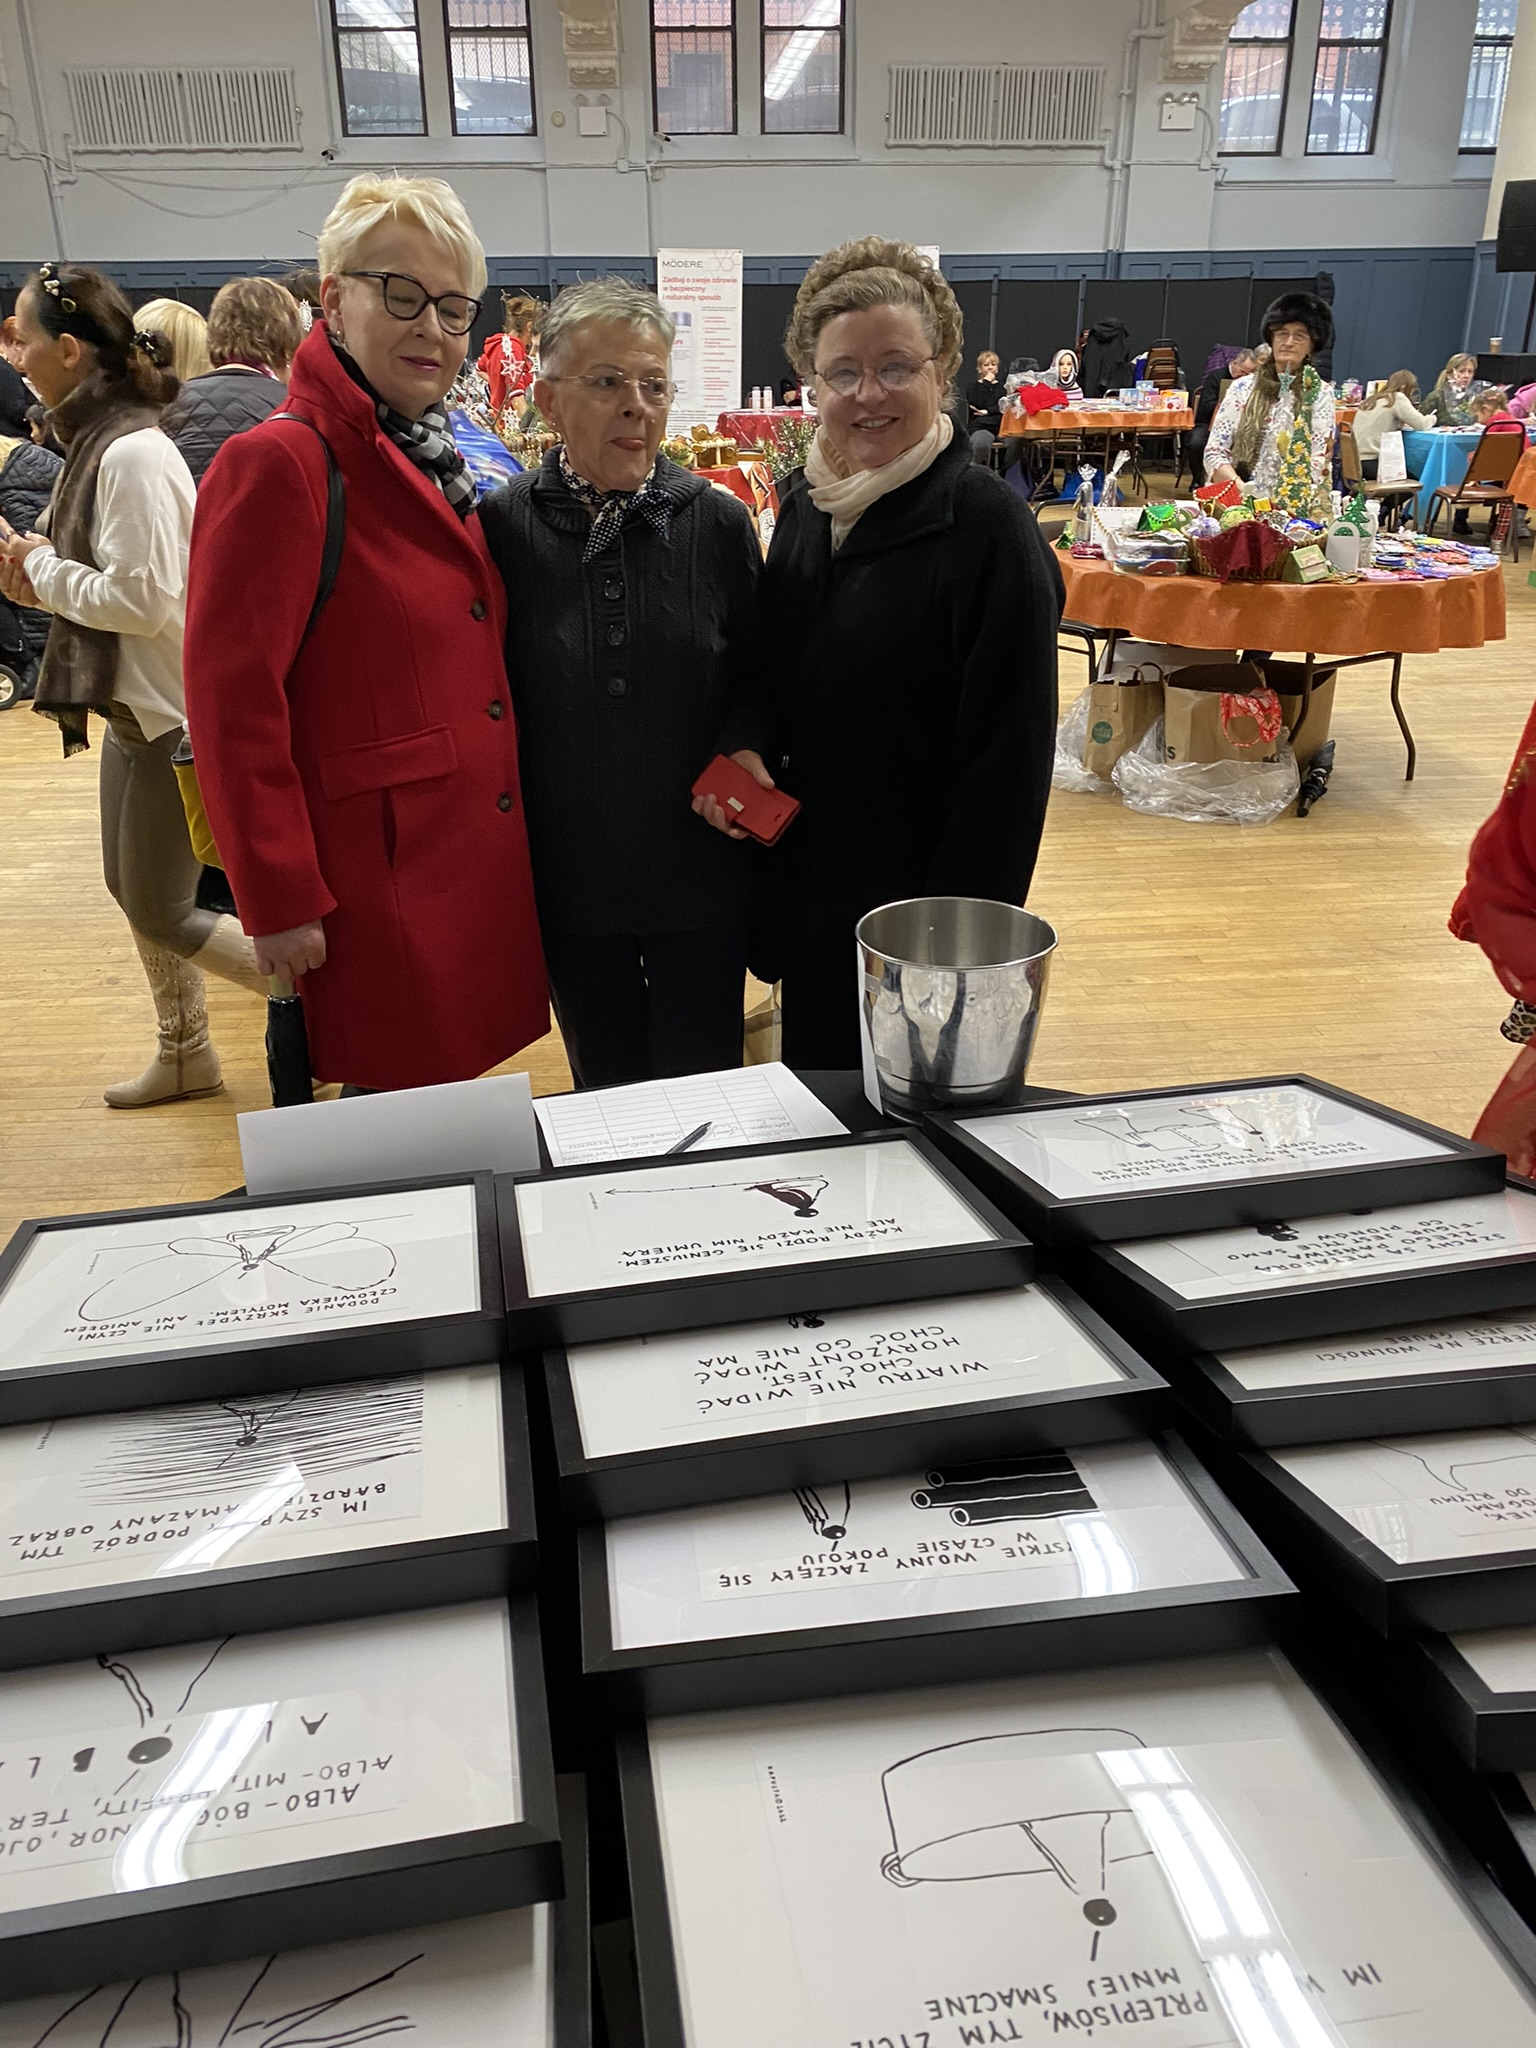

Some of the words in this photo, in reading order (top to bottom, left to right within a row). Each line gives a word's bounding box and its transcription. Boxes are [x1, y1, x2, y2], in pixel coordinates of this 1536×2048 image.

[1290, 1140, 1357, 1154] POLEGA
[1116, 1158, 1166, 1167] SWOJE
[1173, 1151, 1230, 1161] ODDAJE
[1164, 1156, 1276, 1174] ODDAWANIEM
[1100, 1172, 1151, 1181] DŁUGU
[822, 1223, 854, 1234] NIE
[866, 1217, 896, 1228] ALE
[1418, 1218, 1443, 1226] CO
[756, 1228, 815, 1244] KAŻDY
[843, 1226, 903, 1240] KAŻDY
[1351, 1232, 1392, 1244] JEST
[1399, 1230, 1476, 1245] ZŁEGO
[711, 1238, 745, 1247] NIM
[737, 1243, 764, 1253] SIĘ
[776, 1236, 830, 1248] RODZI
[1296, 1240, 1341, 1251] TYLE
[1428, 1232, 1506, 1250] SZACHY
[621, 1242, 701, 1258] UMIERA
[1227, 1248, 1287, 1260] SAMO
[1286, 1242, 1386, 1260] PAŃSTWA
[618, 1249, 724, 1267] GENIUSZEM.
[300, 1286, 397, 1306] CZŁOWIEKA
[209, 1302, 290, 1316] MOTYLEM.
[303, 1296, 380, 1314] DODANIE
[156, 1314, 188, 1324] ANI
[196, 1308, 290, 1326] SKRZYDEŁ
[63, 1320, 142, 1334] ANIOŁEM
[78, 1328, 127, 1341] CZYNI
[143, 1323, 174, 1334] NIE
[1464, 1327, 1505, 1337] JEST
[1383, 1331, 1452, 1345] GRUBE
[1428, 1340, 1464, 1350] NA
[756, 1346, 800, 1360] NIE
[808, 1337, 960, 1368] HORYZONT
[816, 1339, 852, 1353] GO
[697, 1354, 738, 1368] MA
[1314, 1346, 1420, 1362] WOLNOŚCI
[694, 1360, 788, 1384] WIDAĆ
[840, 1356, 912, 1378] CHOĆ
[877, 1360, 988, 1386] WIATRU
[762, 1370, 822, 1388] JEST.
[808, 1380, 856, 1395] NIE
[696, 1388, 793, 1414] WIDAĆ
[1429, 1492, 1496, 1506] RZYMU
[1505, 1488, 1531, 1498] DO
[342, 1500, 368, 1514] IM
[1464, 1498, 1536, 1512] OGAMI
[110, 1502, 240, 1531] AMAZANY
[8, 1525, 94, 1547] OBRAZ
[92, 1526, 190, 1552] PODRÓŻ
[1016, 1531, 1038, 1542] W
[20, 1545, 64, 1560] TYM
[916, 1537, 995, 1554] CZASIE
[800, 1546, 888, 1565] POKOJU
[895, 1551, 977, 1570] WOJNY
[769, 1562, 868, 1583] ZACZĘŁY
[719, 1573, 752, 1588] SIĘ
[230, 1772, 286, 1794] MIT,
[0, 1808, 70, 1832] TER
[1085, 1966, 1181, 1998] MNIEJ
[1341, 1962, 1383, 1988] IM
[924, 1983, 1058, 2020] SMACZNE
[1042, 1989, 1210, 2037] PRZEPISÓW,
[958, 2016, 1022, 2046] TYM
